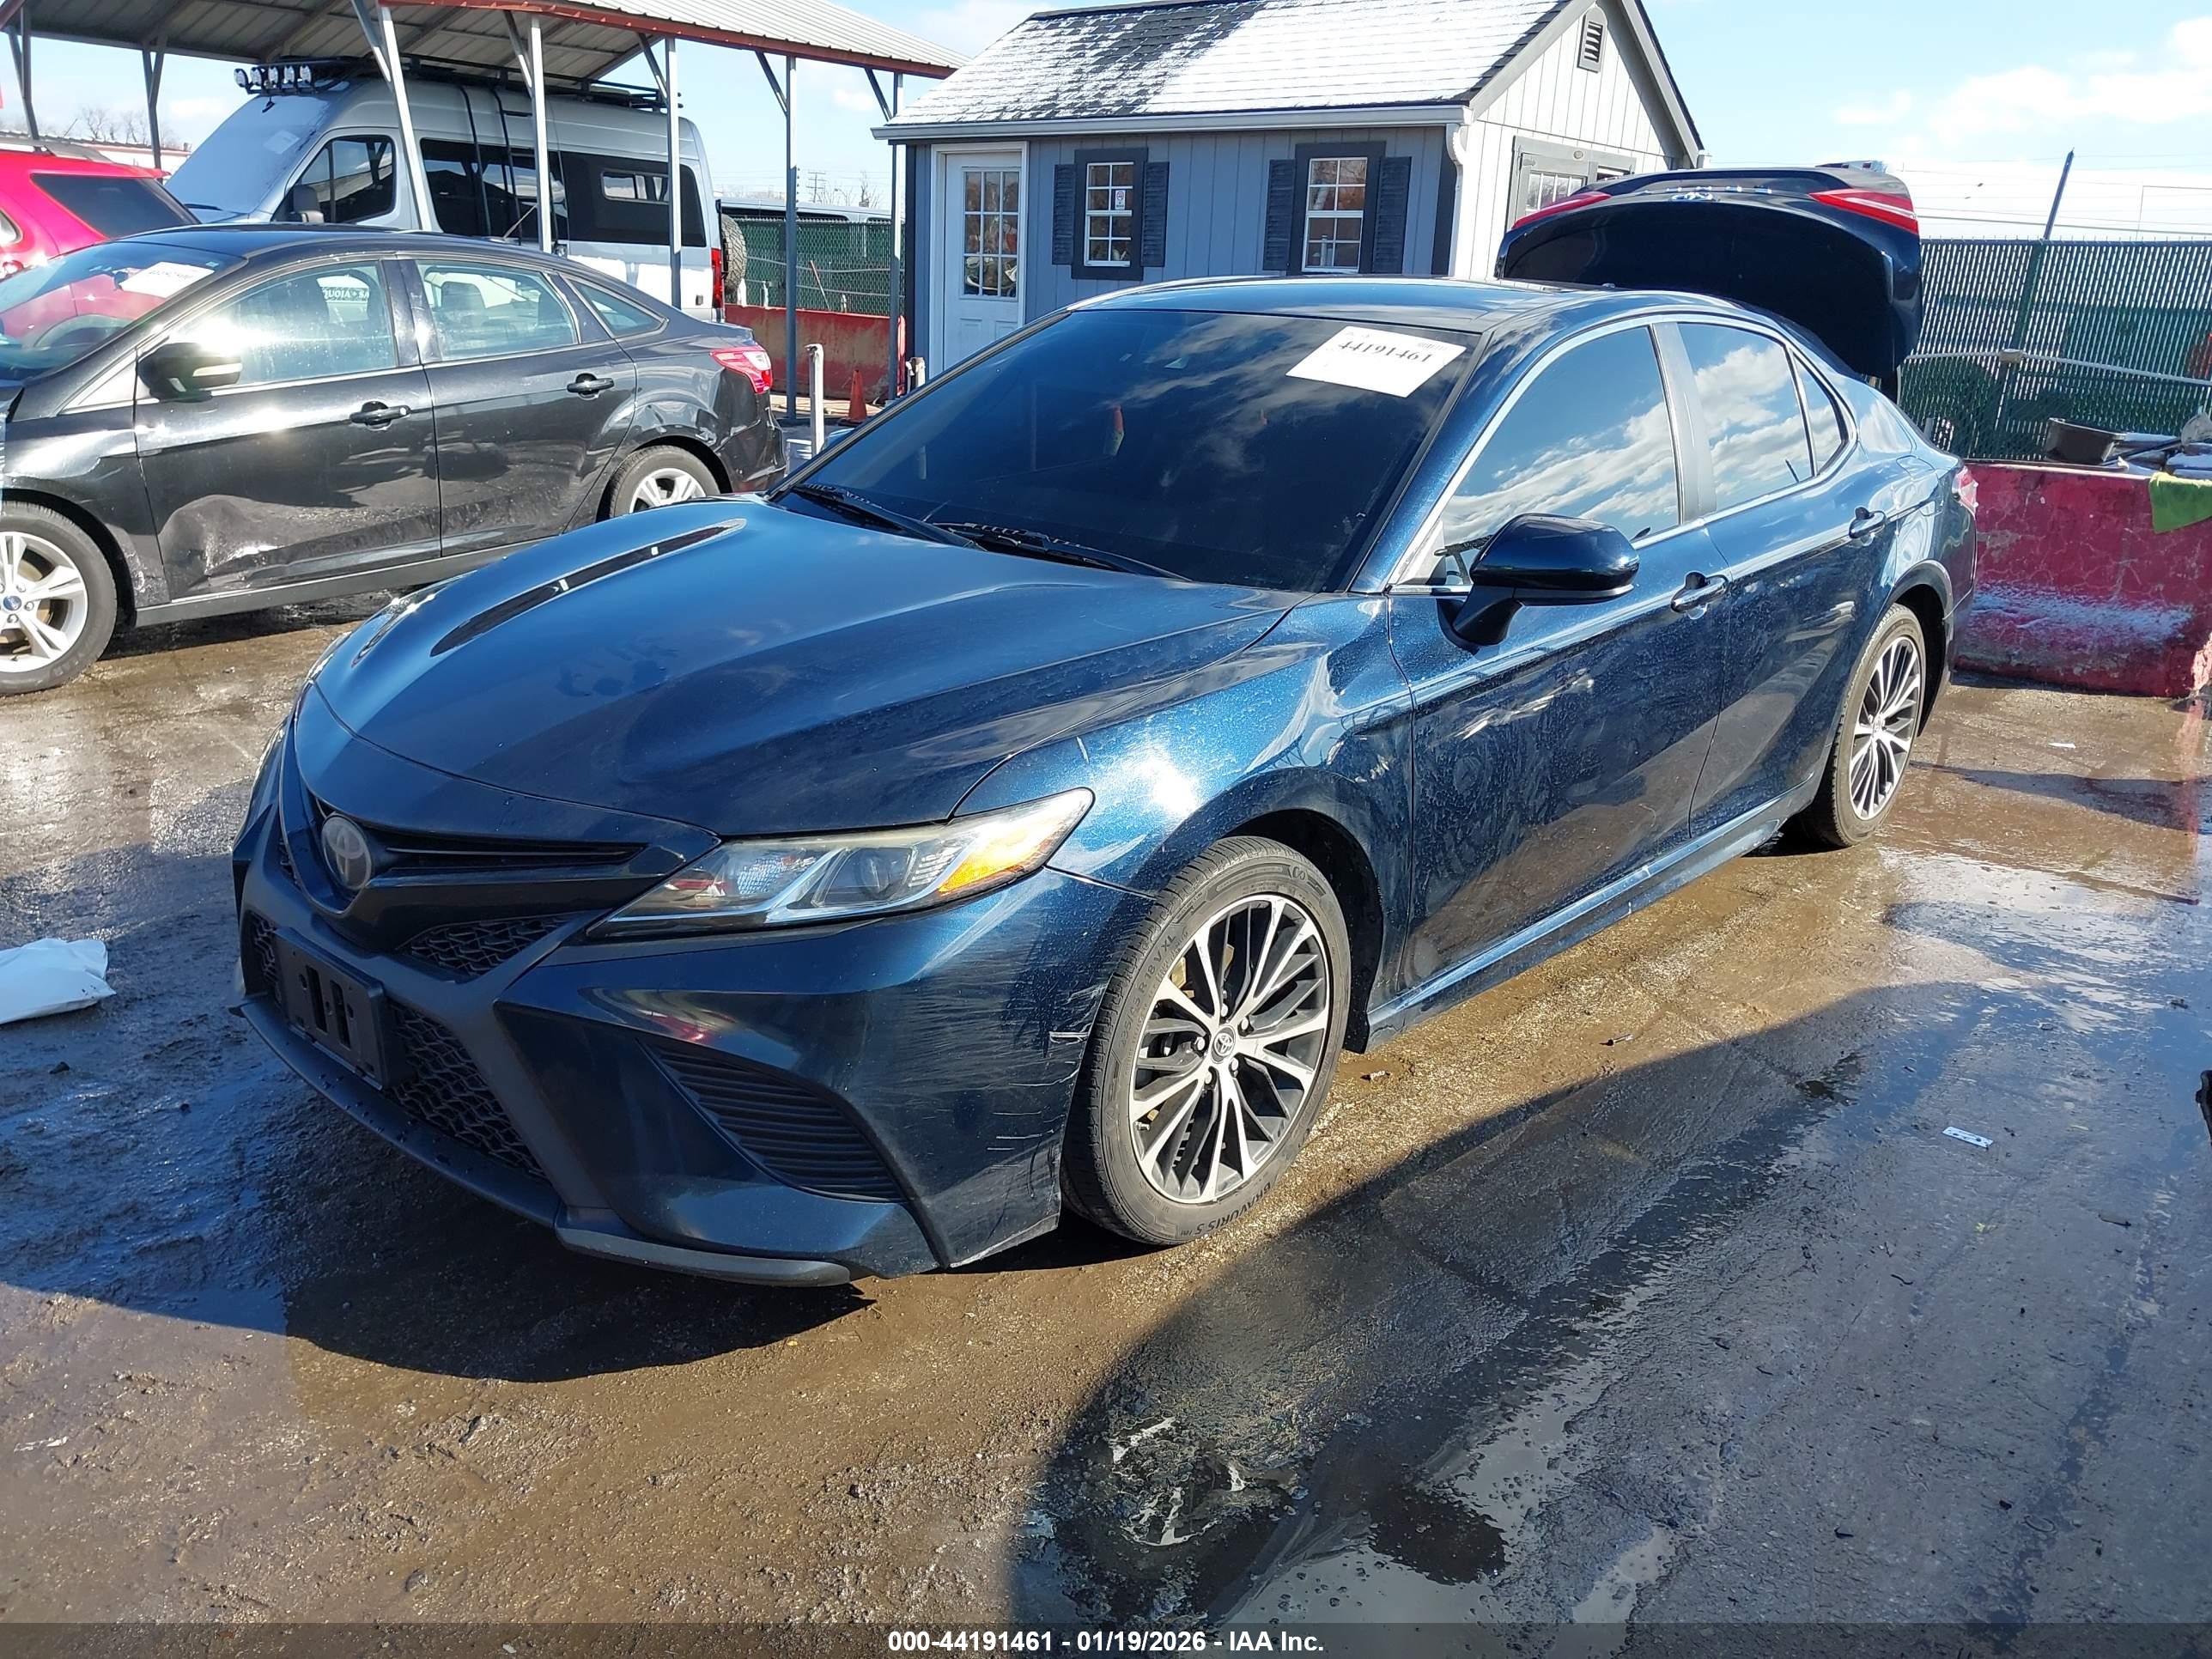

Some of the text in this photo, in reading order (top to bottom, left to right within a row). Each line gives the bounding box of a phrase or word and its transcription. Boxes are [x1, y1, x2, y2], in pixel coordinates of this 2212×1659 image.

[1338, 341, 1433, 362] 44191461
[1145, 964, 1156, 980] 18
[1206, 1182, 1271, 1232] BRAVURIS
